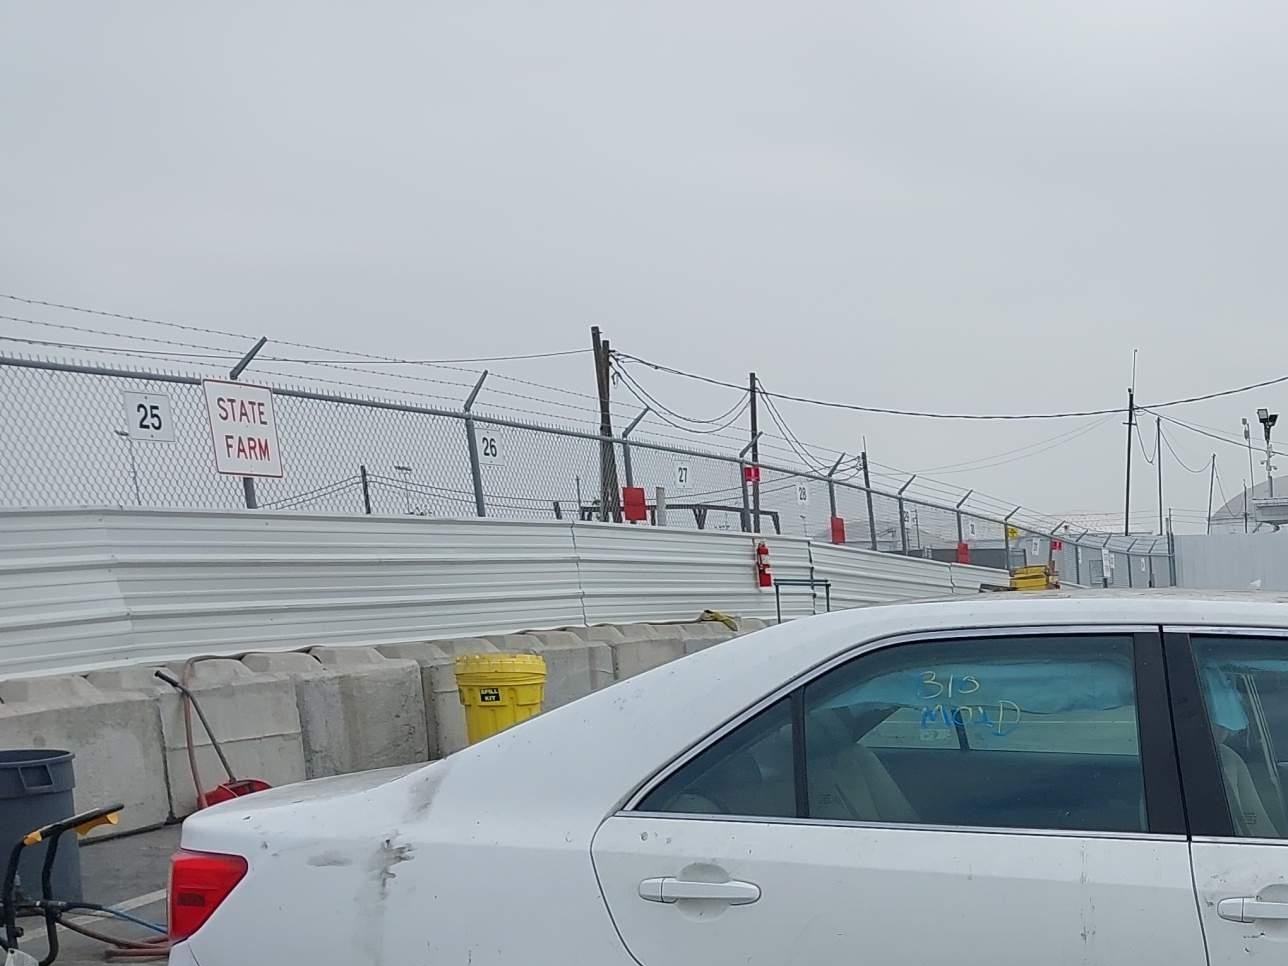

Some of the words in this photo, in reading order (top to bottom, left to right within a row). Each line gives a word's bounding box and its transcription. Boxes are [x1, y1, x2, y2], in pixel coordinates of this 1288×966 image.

[136, 404, 162, 431] 25
[217, 397, 268, 426] STATE
[225, 435, 271, 462] FARM
[482, 436, 497, 457] 26
[678, 467, 687, 483] 27
